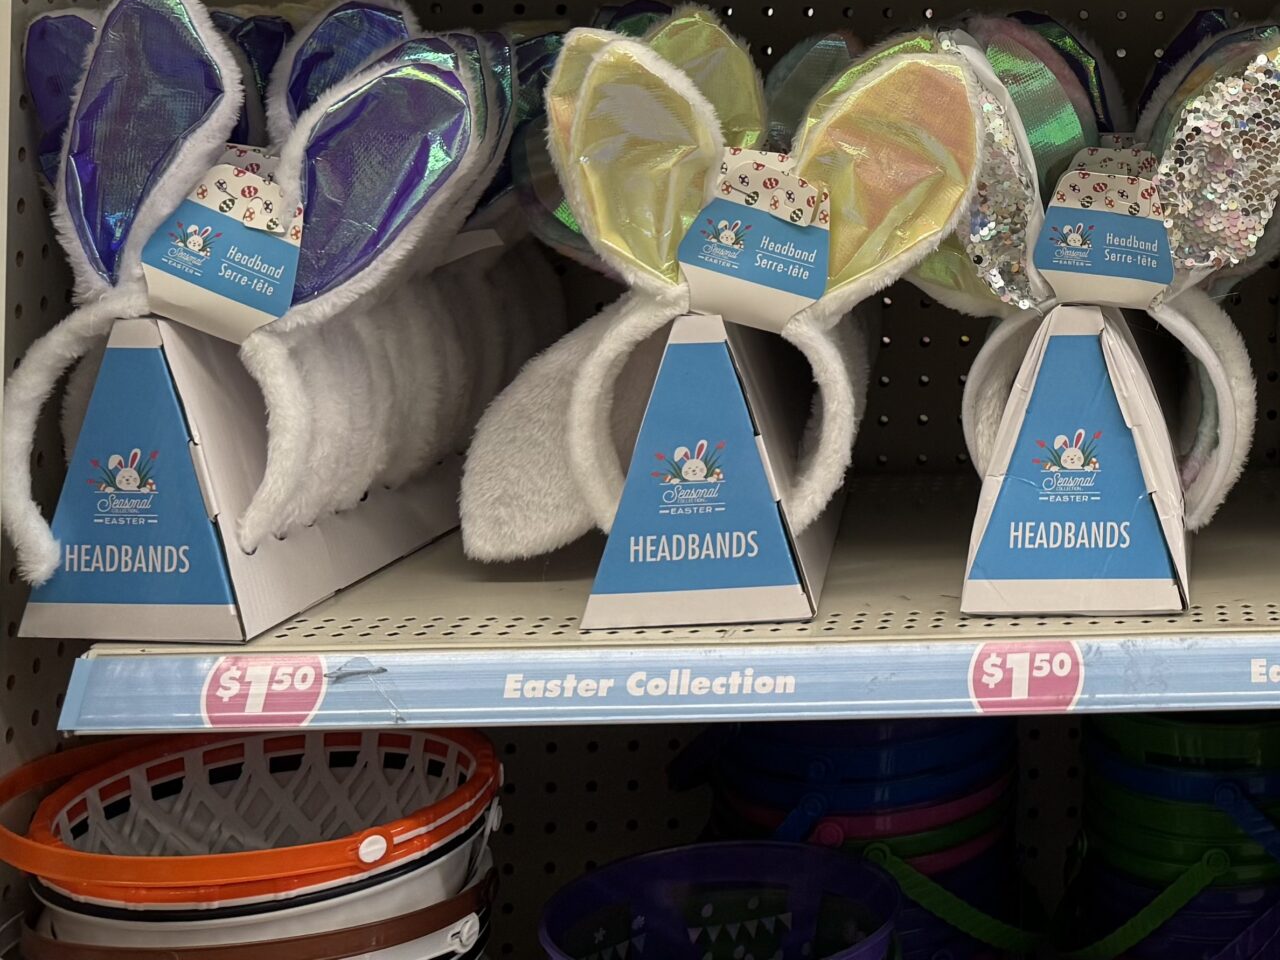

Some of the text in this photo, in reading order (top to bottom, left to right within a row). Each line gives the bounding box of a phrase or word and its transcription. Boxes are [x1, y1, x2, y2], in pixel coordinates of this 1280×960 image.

[760, 235, 817, 263] Headband
[1106, 233, 1158, 252] Headband
[167, 260, 195, 275] EASTER
[226, 245, 285, 279] Headband
[754, 253, 810, 280] Serre-tête
[1104, 248, 1157, 268] Serre-tête
[218, 263, 274, 296] Serre-tête
[662, 483, 720, 503] Seasonal
[1042, 473, 1097, 491] Seasonal
[97, 494, 154, 513] Seasonal
[670, 506, 713, 515] EASTER
[1049, 495, 1089, 503] EASTER
[629, 530, 759, 563] HEADBANDS
[1009, 521, 1131, 549] HEADBANDS
[65, 544, 190, 574] HEADBANDS
[503, 667, 797, 699] Easter Collection
